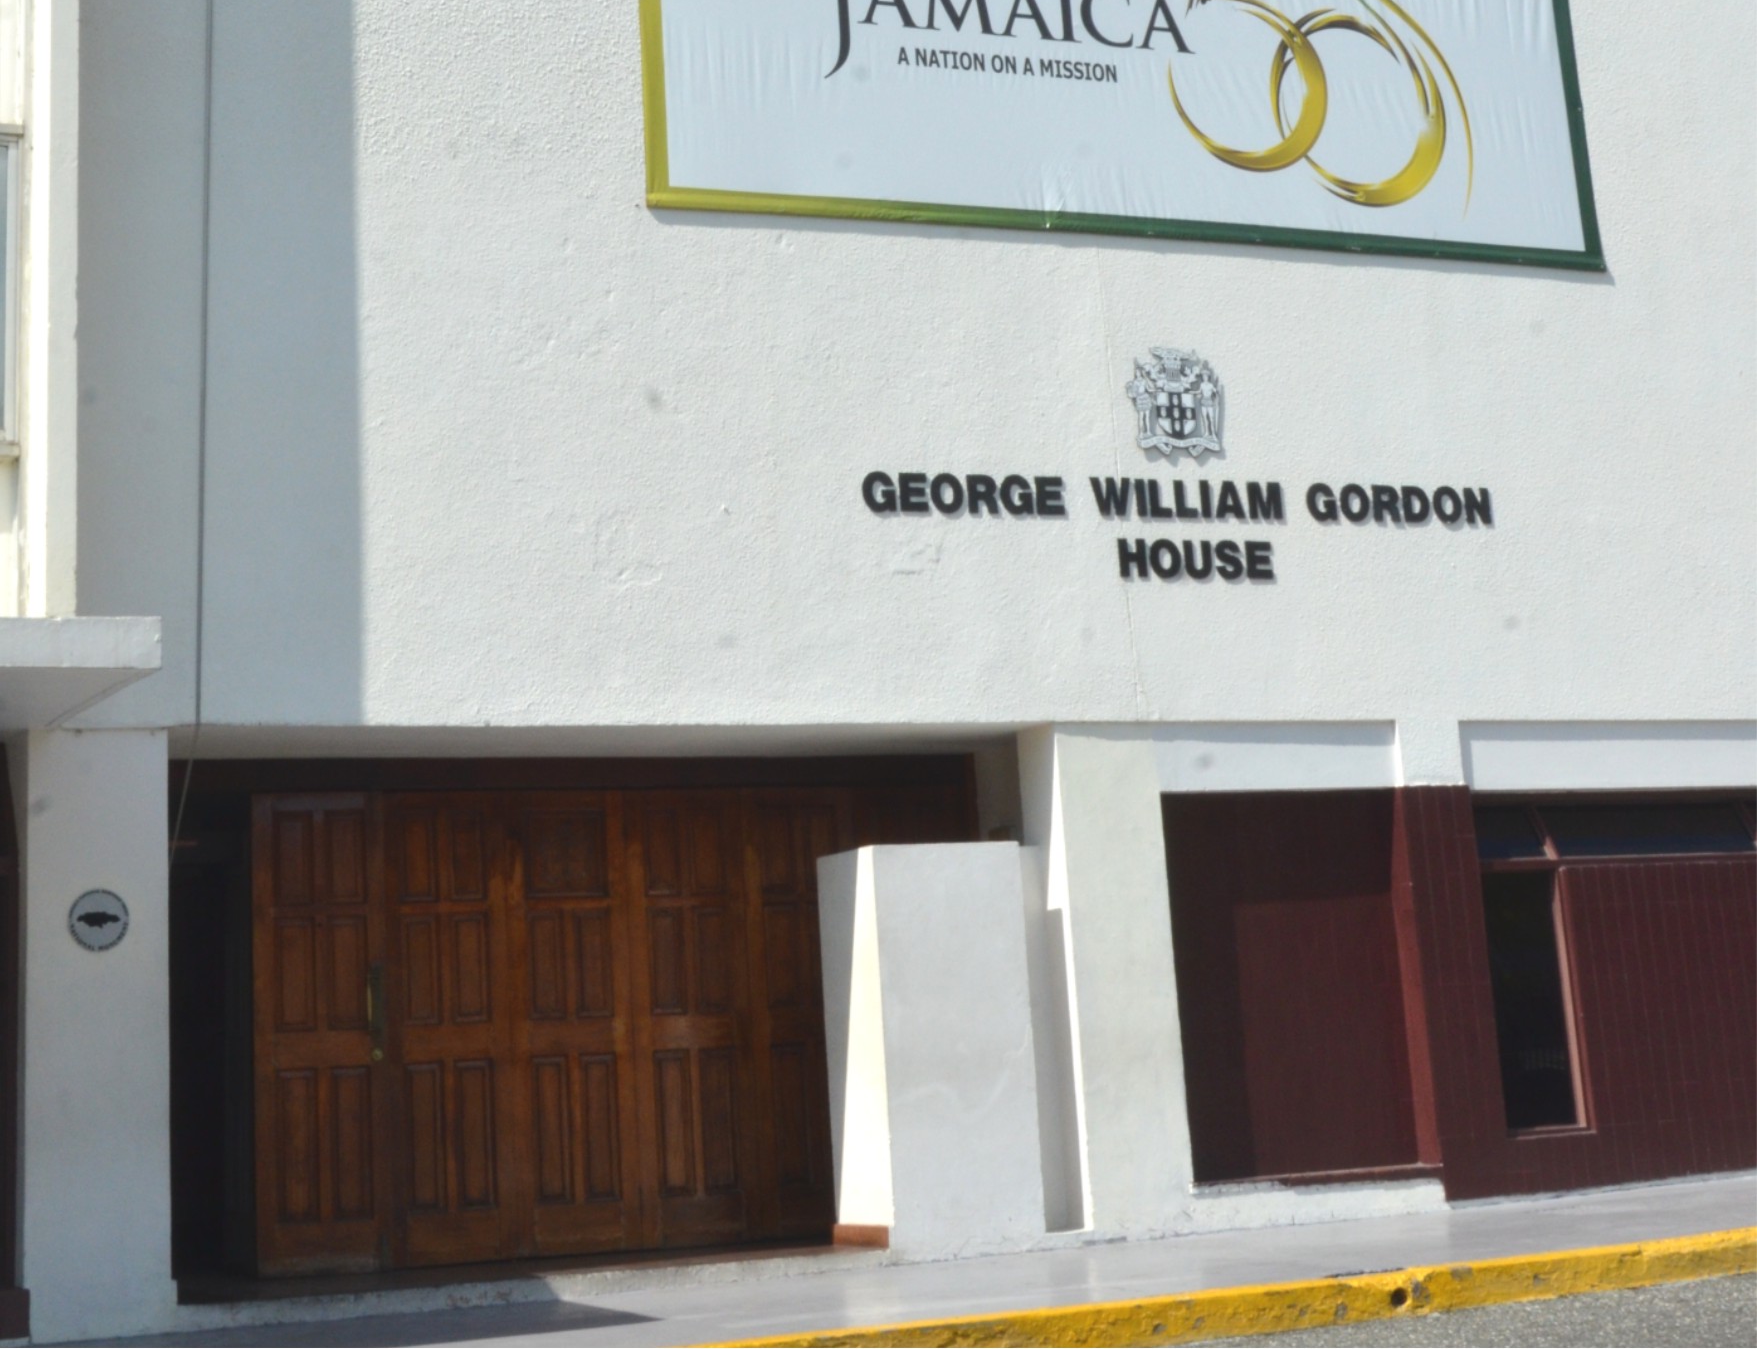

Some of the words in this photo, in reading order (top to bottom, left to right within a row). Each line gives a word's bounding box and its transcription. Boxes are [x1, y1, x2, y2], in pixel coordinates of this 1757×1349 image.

[898, 47, 909, 66] A
[916, 49, 985, 71] NATION
[992, 55, 1016, 74] ON
[1024, 58, 1034, 75] A
[1040, 59, 1117, 82] MISSION
[863, 472, 1065, 515] GEORGE
[1090, 477, 1283, 520] WILLIAM
[1307, 484, 1491, 524] GORDON
[1118, 539, 1273, 580] HOUSE
